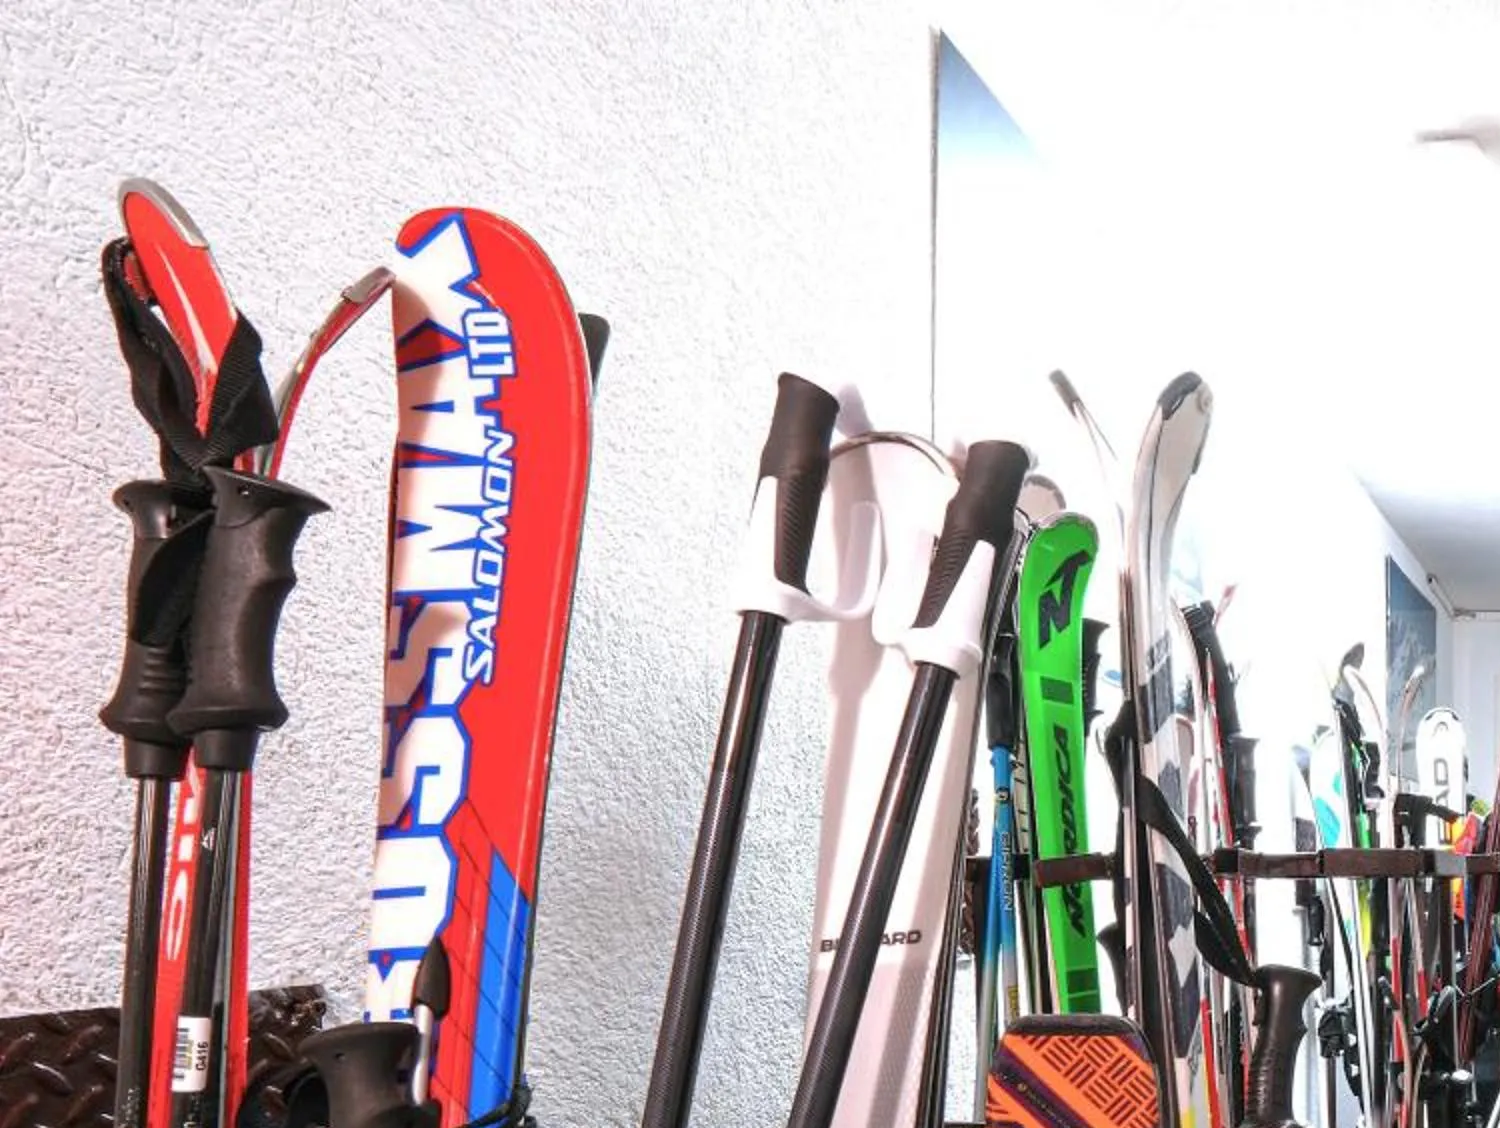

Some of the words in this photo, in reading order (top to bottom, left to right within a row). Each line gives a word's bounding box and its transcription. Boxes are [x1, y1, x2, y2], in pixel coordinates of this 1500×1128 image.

[467, 306, 516, 377] LTD
[365, 212, 482, 1024] ROSSMAX
[462, 429, 517, 688] SALOMON
